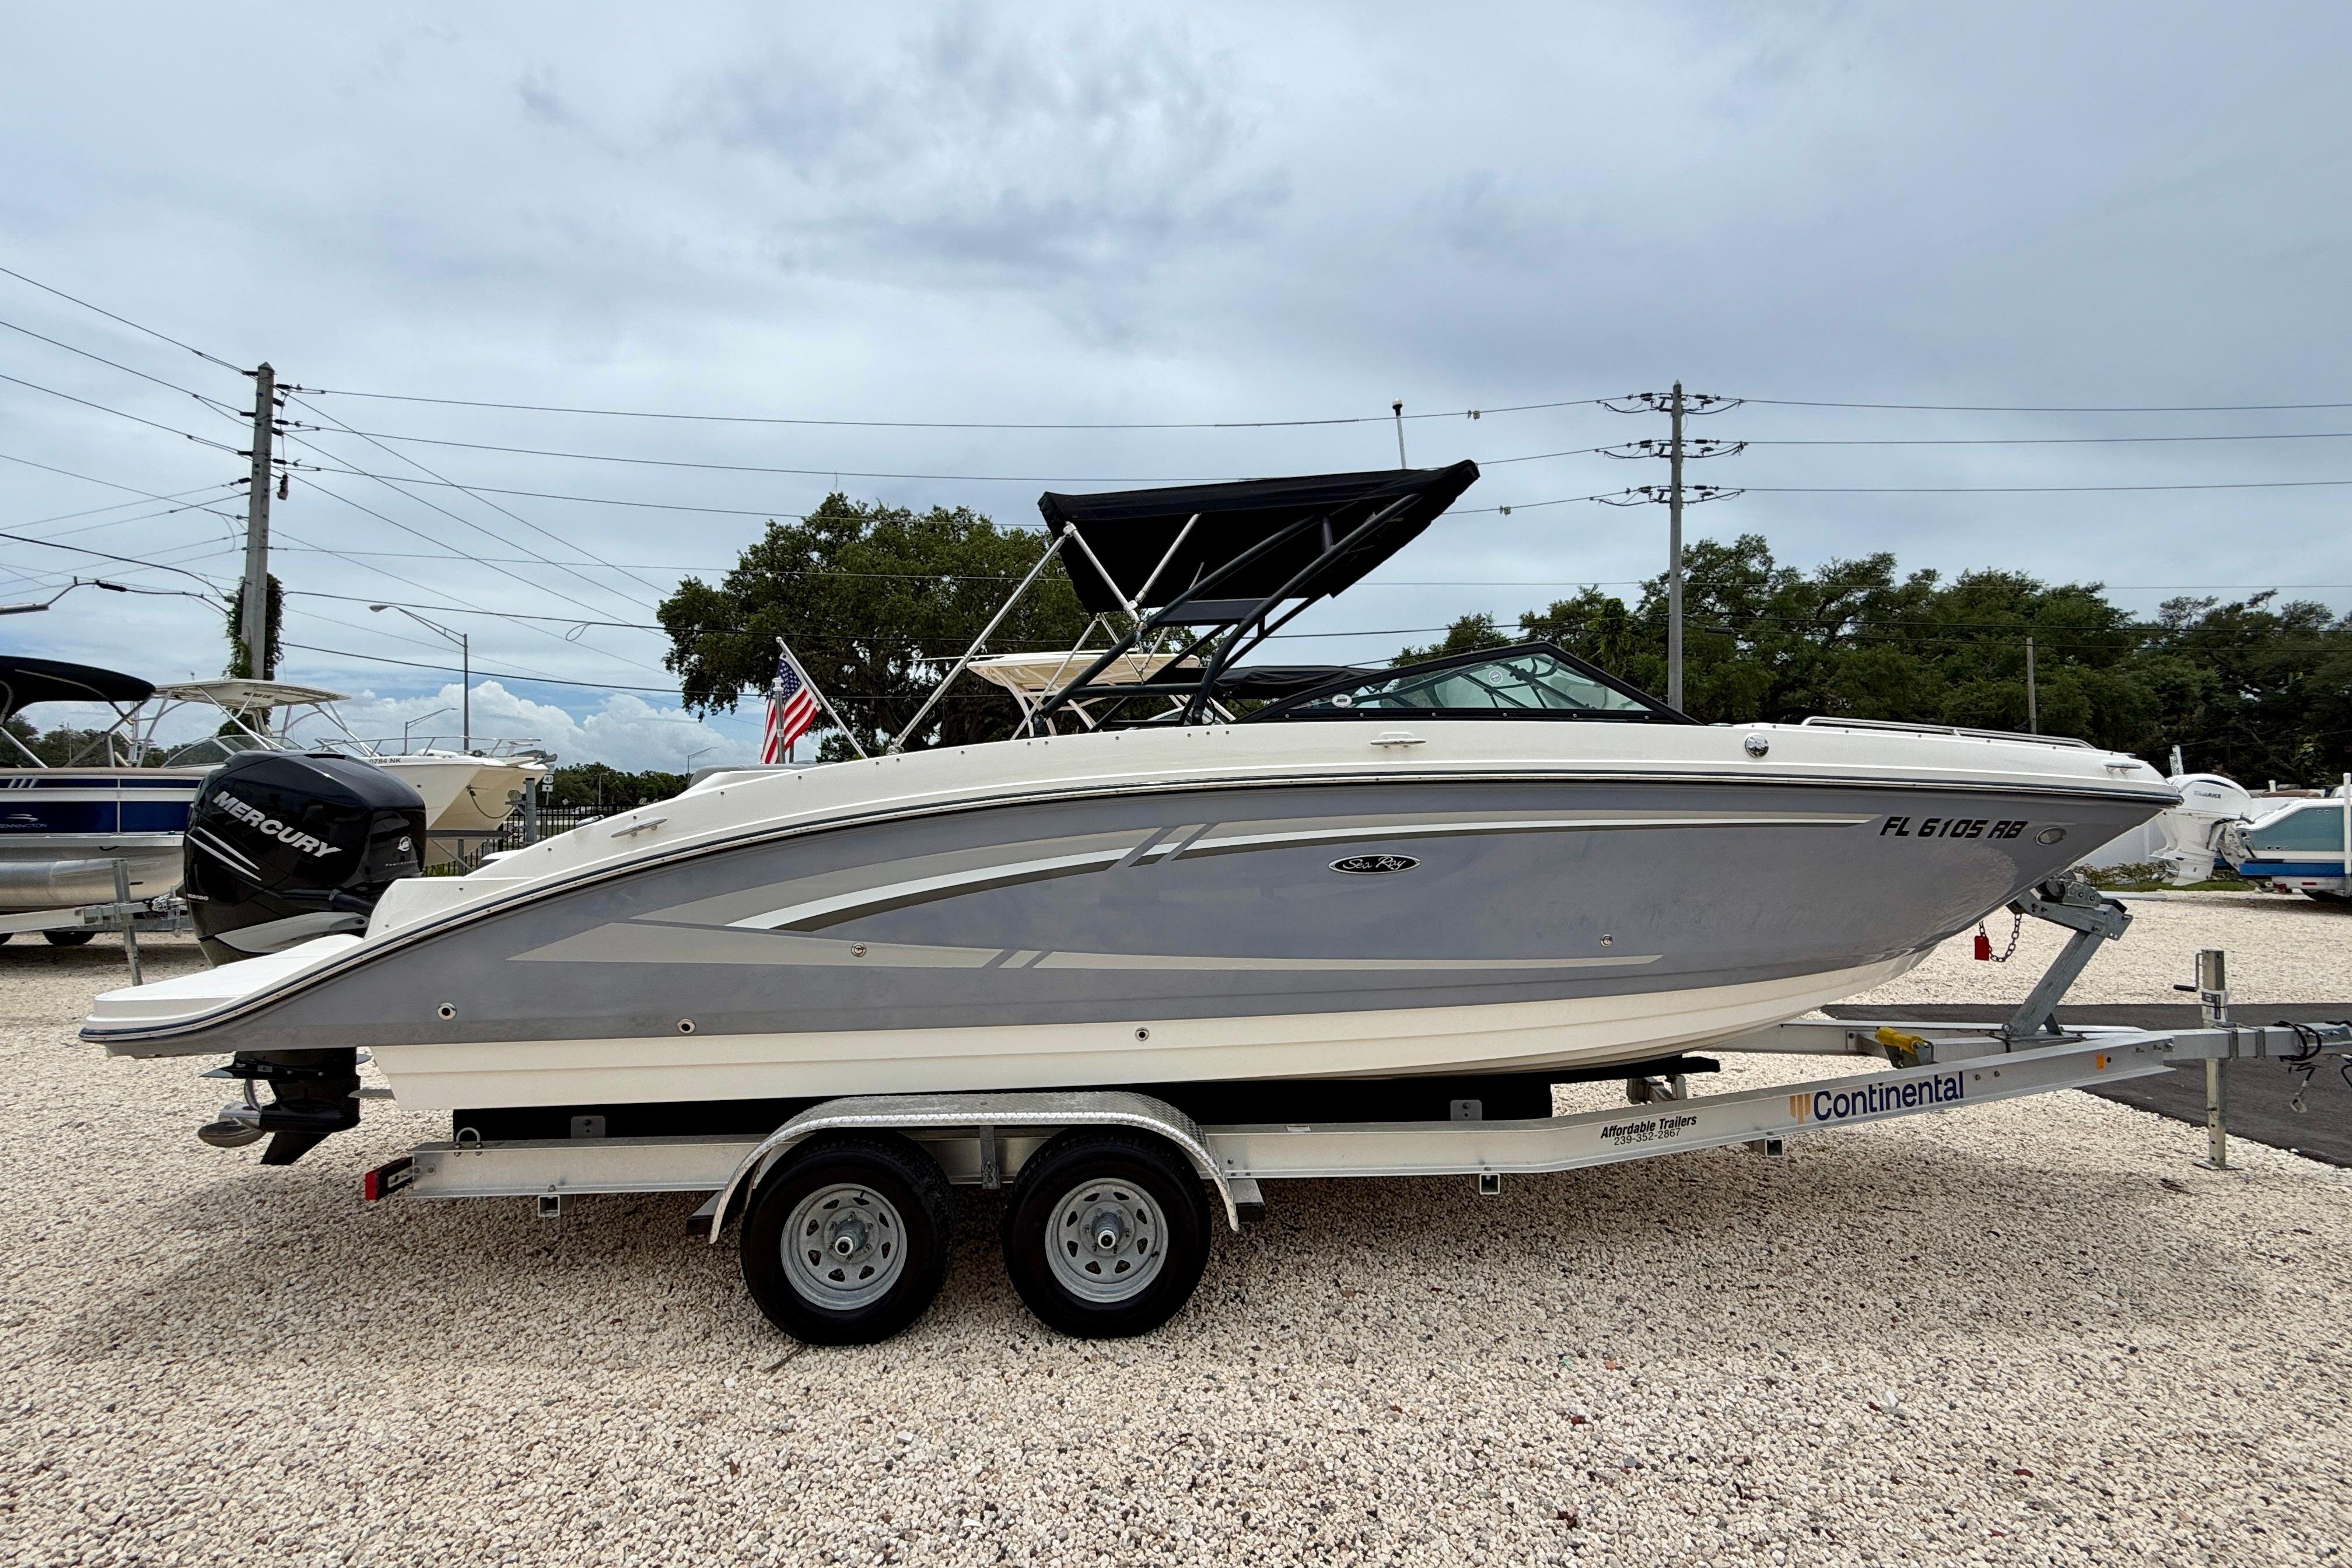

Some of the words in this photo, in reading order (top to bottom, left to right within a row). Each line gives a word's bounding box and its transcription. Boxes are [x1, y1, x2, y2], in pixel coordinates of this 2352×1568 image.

[212, 790, 342, 858] MERCURY
[1880, 817, 1912, 836] FL
[1917, 818, 1989, 838] 6105
[1342, 859, 1373, 869] Sea
[1375, 856, 1406, 870] Ray
[1814, 1071, 1964, 1121] Continental
[1600, 1121, 1656, 1139] Affordable
[1659, 1116, 1697, 1130] Trailers
[1614, 1128, 1681, 1146] 239-352-2867
